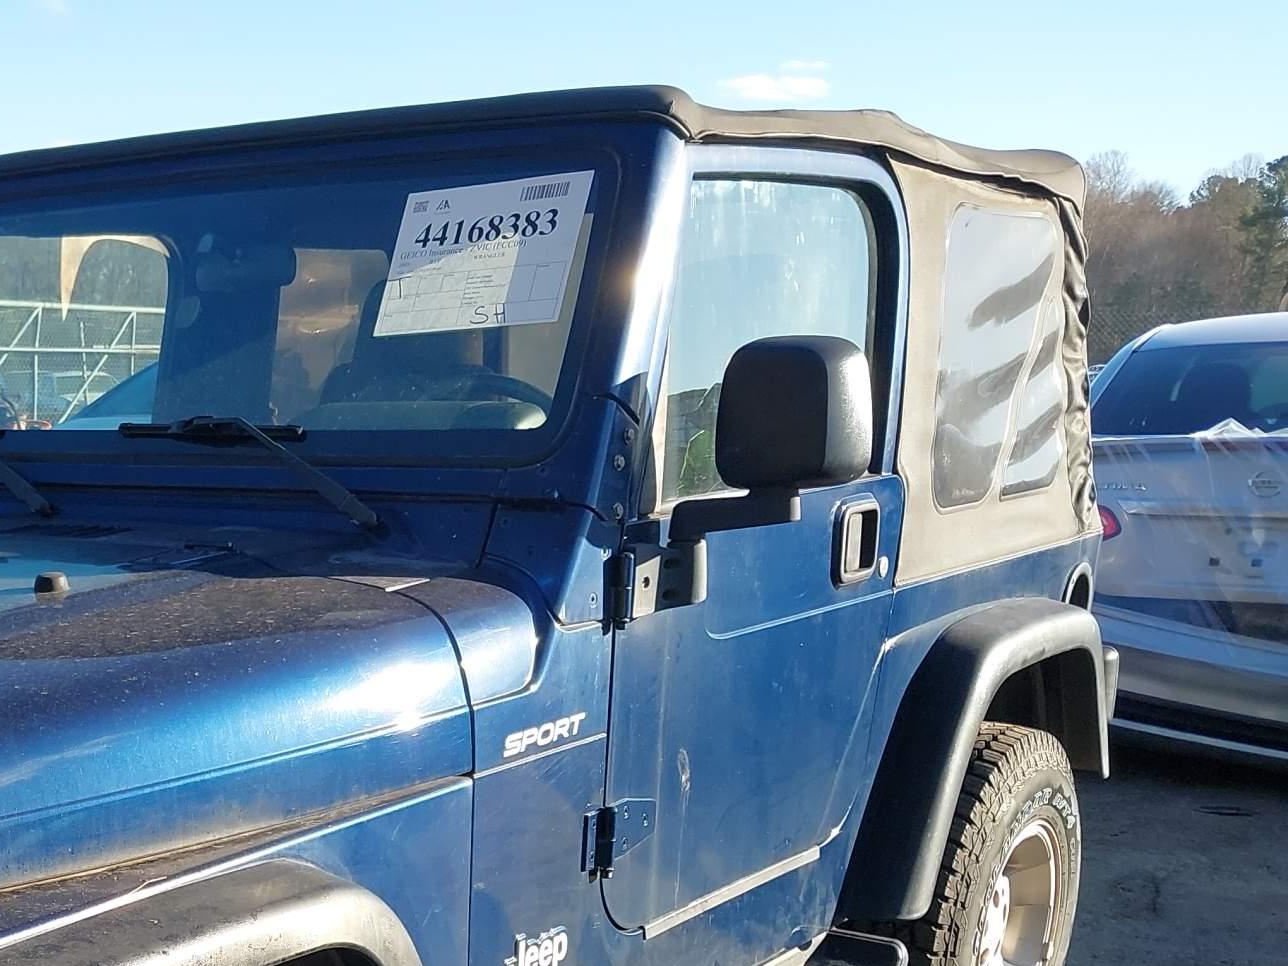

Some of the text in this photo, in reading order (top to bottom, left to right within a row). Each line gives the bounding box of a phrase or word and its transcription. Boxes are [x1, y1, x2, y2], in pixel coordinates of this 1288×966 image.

[414, 208, 559, 249] 44168383
[400, 249, 427, 260] GEICO
[428, 246, 463, 257] Insurance
[503, 711, 586, 758] SPORT
